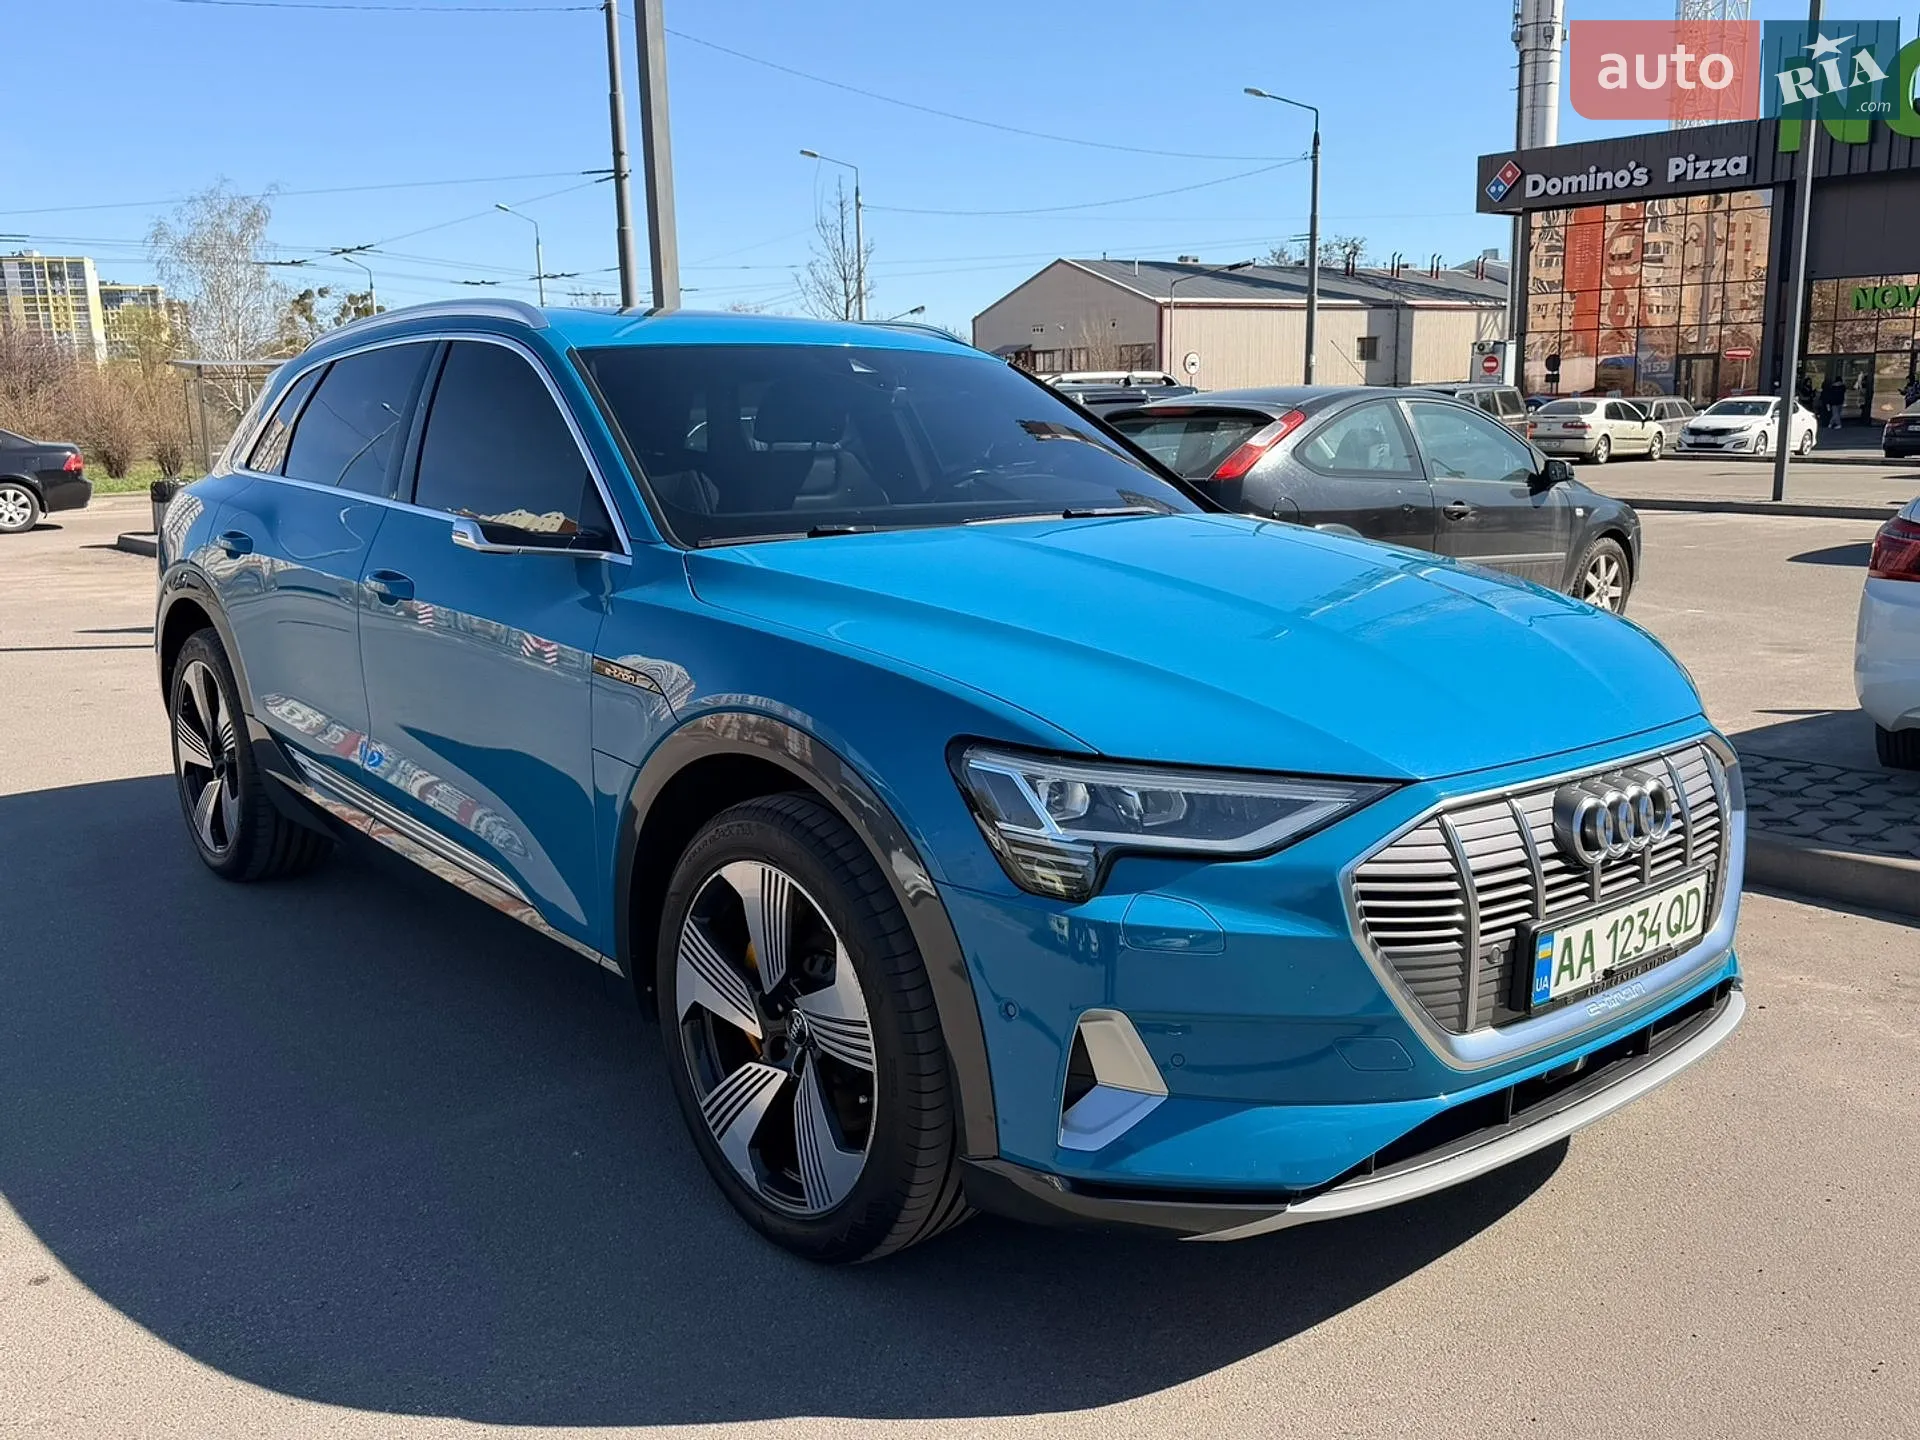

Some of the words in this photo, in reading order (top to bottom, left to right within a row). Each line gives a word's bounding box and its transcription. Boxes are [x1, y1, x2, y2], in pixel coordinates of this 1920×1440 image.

[1525, 160, 1652, 198] Domino's
[1667, 153, 1749, 183] Pizza
[1554, 928, 1596, 987] AA
[1606, 902, 1663, 965] 1234
[1666, 887, 1701, 939] QD
[1536, 977, 1549, 992] UA
